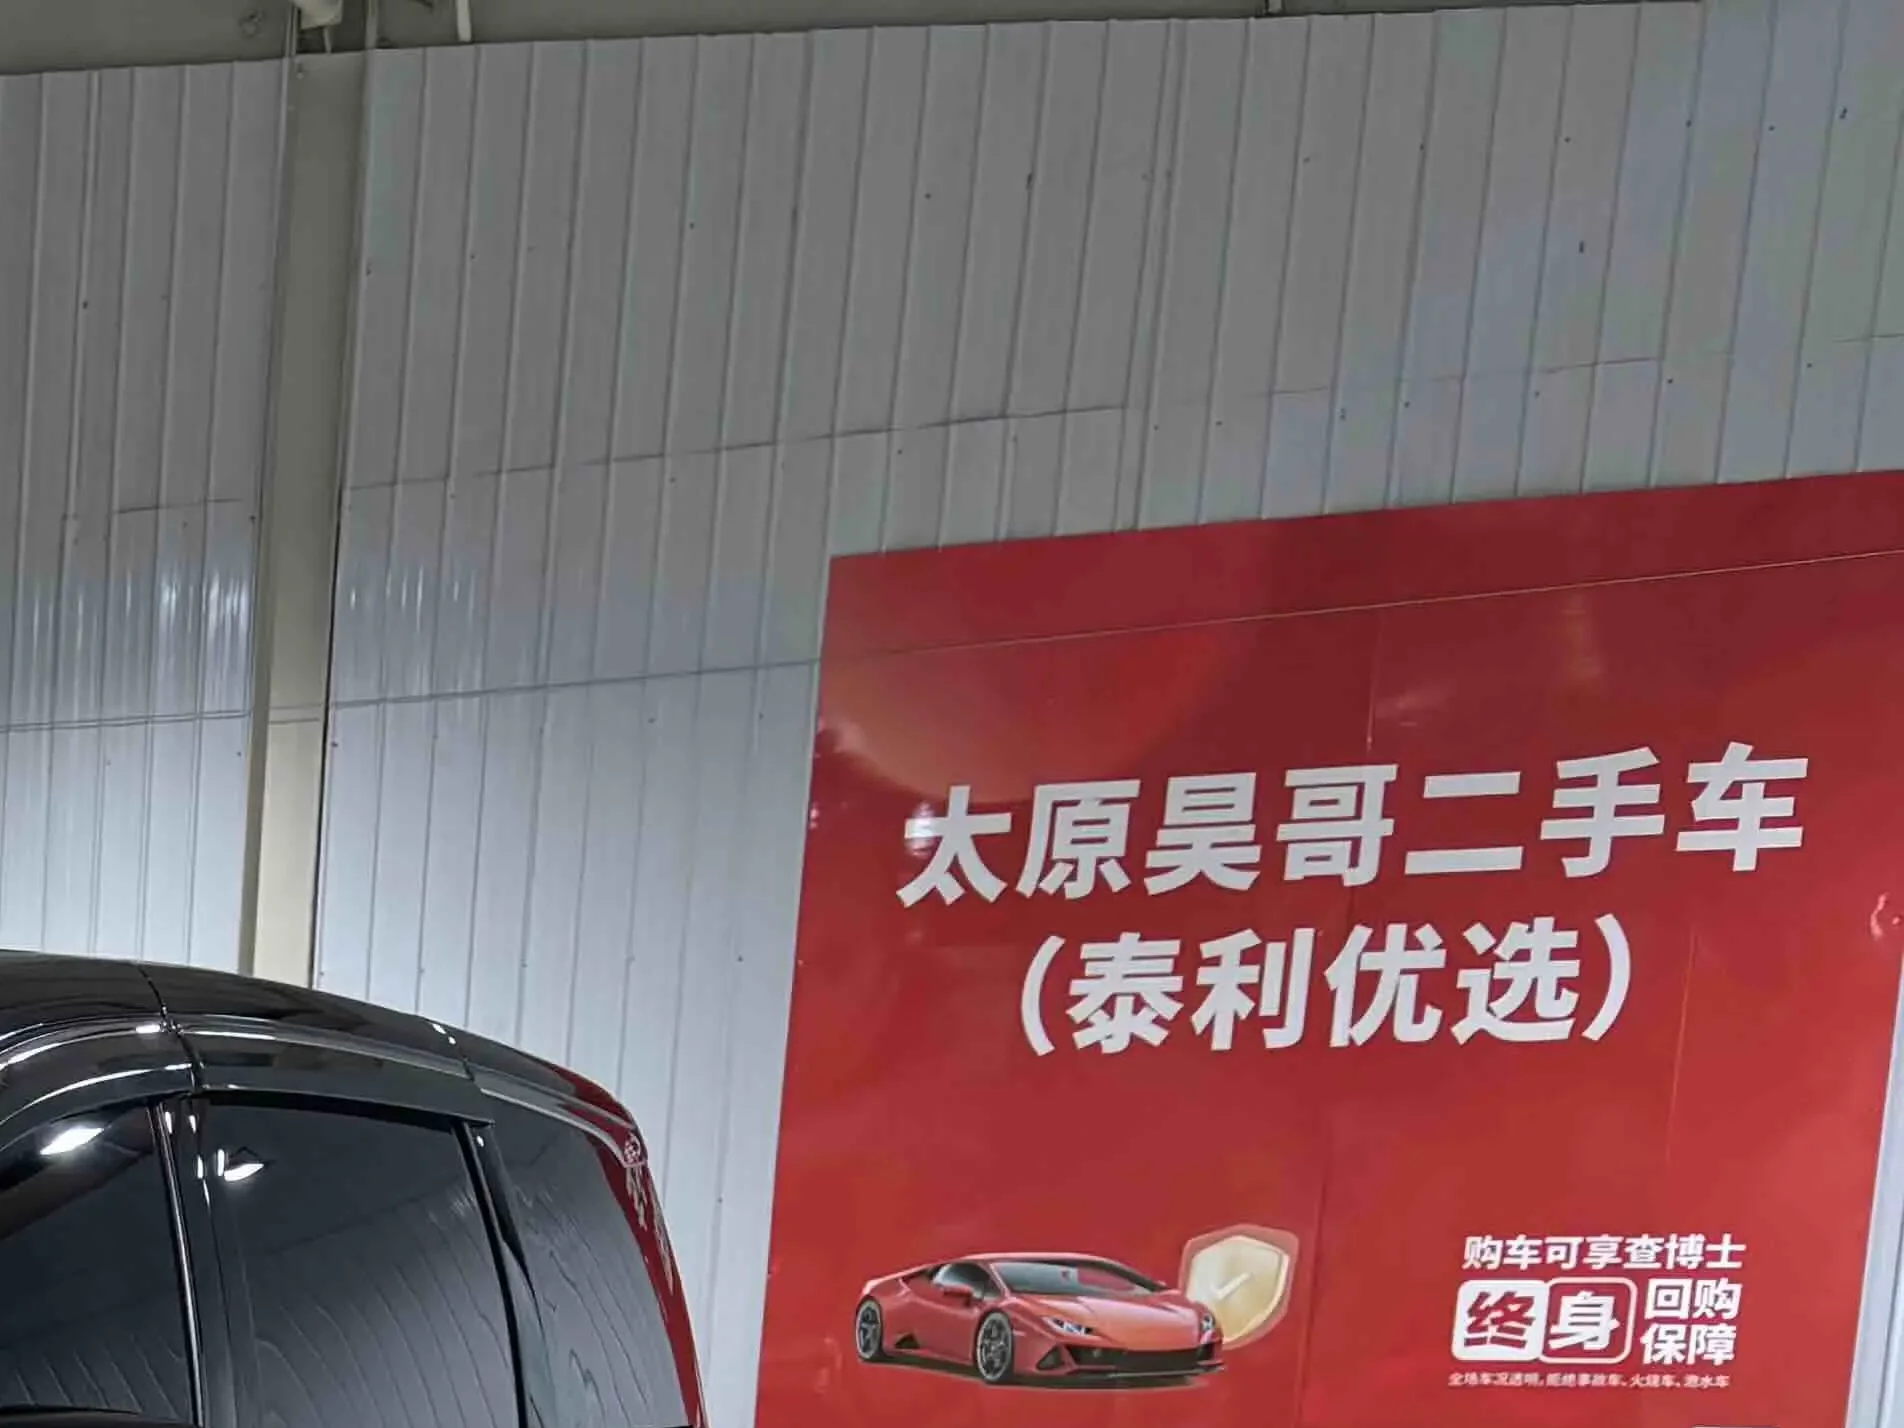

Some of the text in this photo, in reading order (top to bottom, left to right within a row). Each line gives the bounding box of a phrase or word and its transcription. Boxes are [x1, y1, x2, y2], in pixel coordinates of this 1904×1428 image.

[896, 741, 1809, 907] 太原昊哥二手车
[1461, 1233, 1747, 1270] 购车可享查博士
[1462, 1289, 1620, 1351] 终身
[1644, 1278, 1743, 1320] 回购
[1640, 1323, 1737, 1366] 保障
